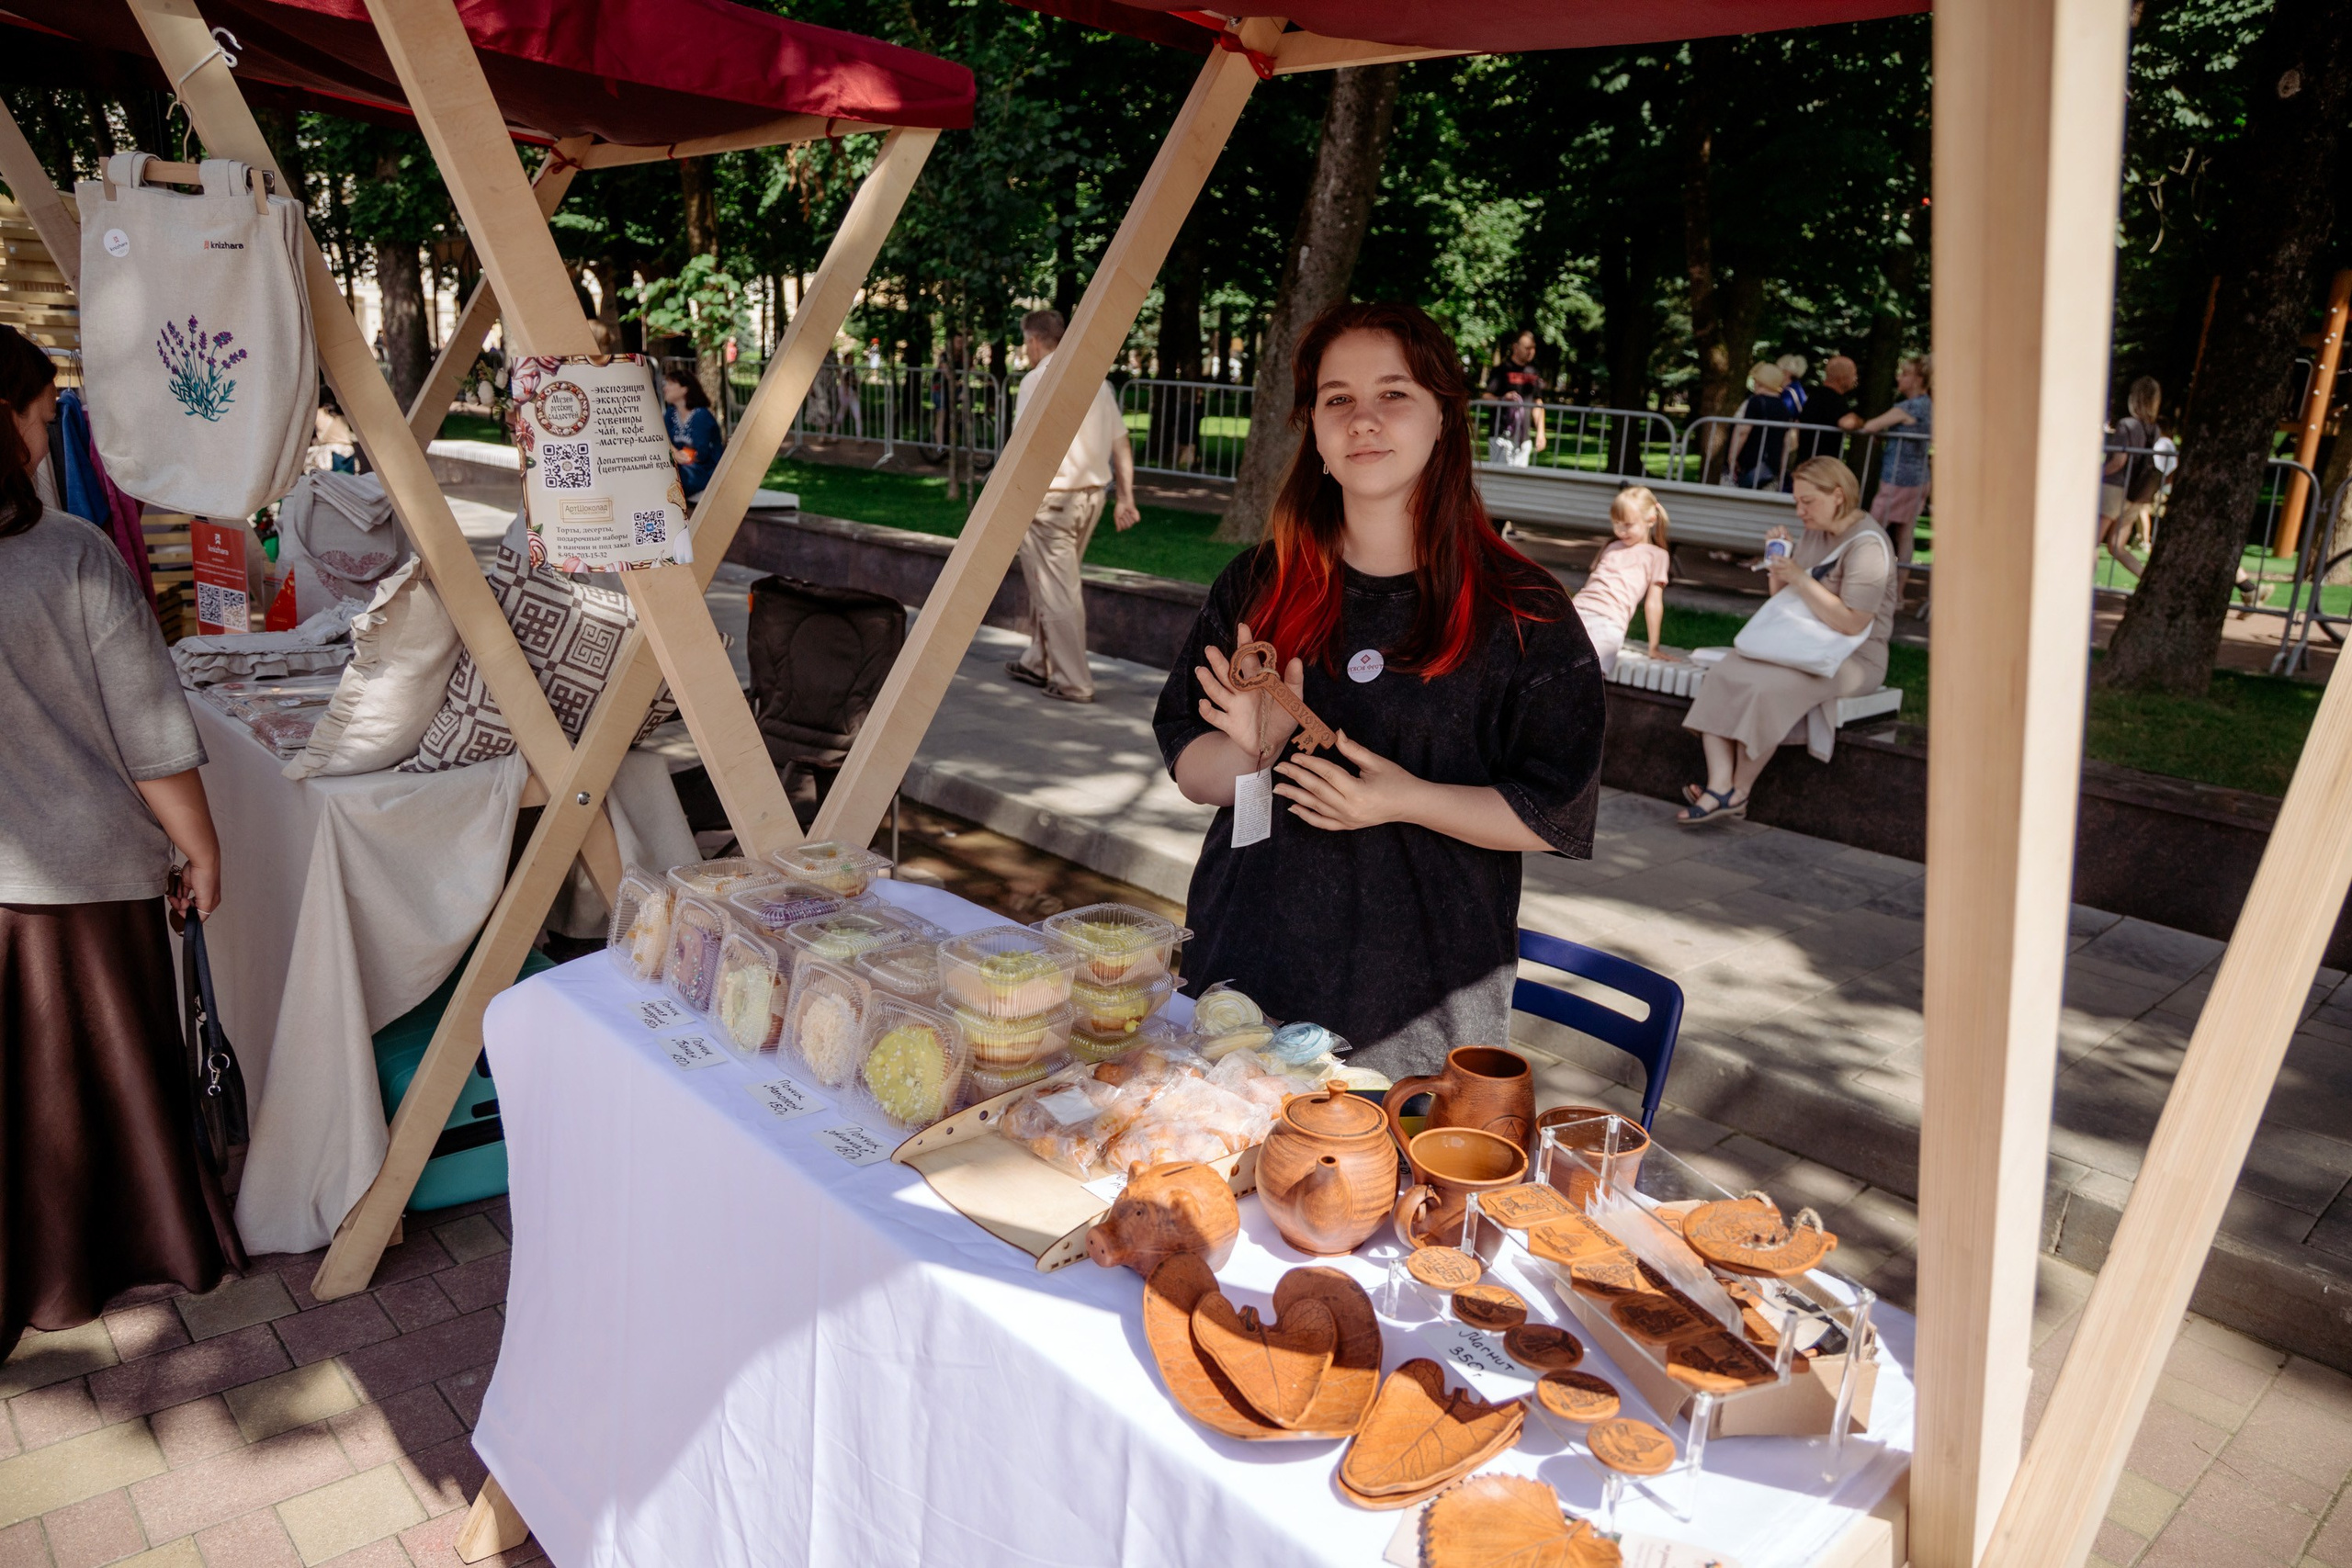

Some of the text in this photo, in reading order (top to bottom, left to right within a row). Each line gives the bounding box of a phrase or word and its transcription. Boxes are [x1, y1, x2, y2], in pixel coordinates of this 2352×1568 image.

[210, 241, 244, 250] knizhara
[551, 395, 573, 404] Музей
[548, 412, 579, 421] сладостей
[622, 424, 645, 435] кофе
[596, 454, 662, 466] Лопатинский сад
[597, 461, 653, 475] (центральный
[565, 504, 608, 513] АртШоколад
[556, 525, 614, 535] Торты, десерты,
[557, 534, 628, 544] подарочные наборы
[1268, 680, 1330, 741] СМОЛЕНСК
[778, 1079, 805, 1101] Пончик
[845, 1127, 884, 1150] Пончик
[1458, 1330, 1515, 1371] Магнит
